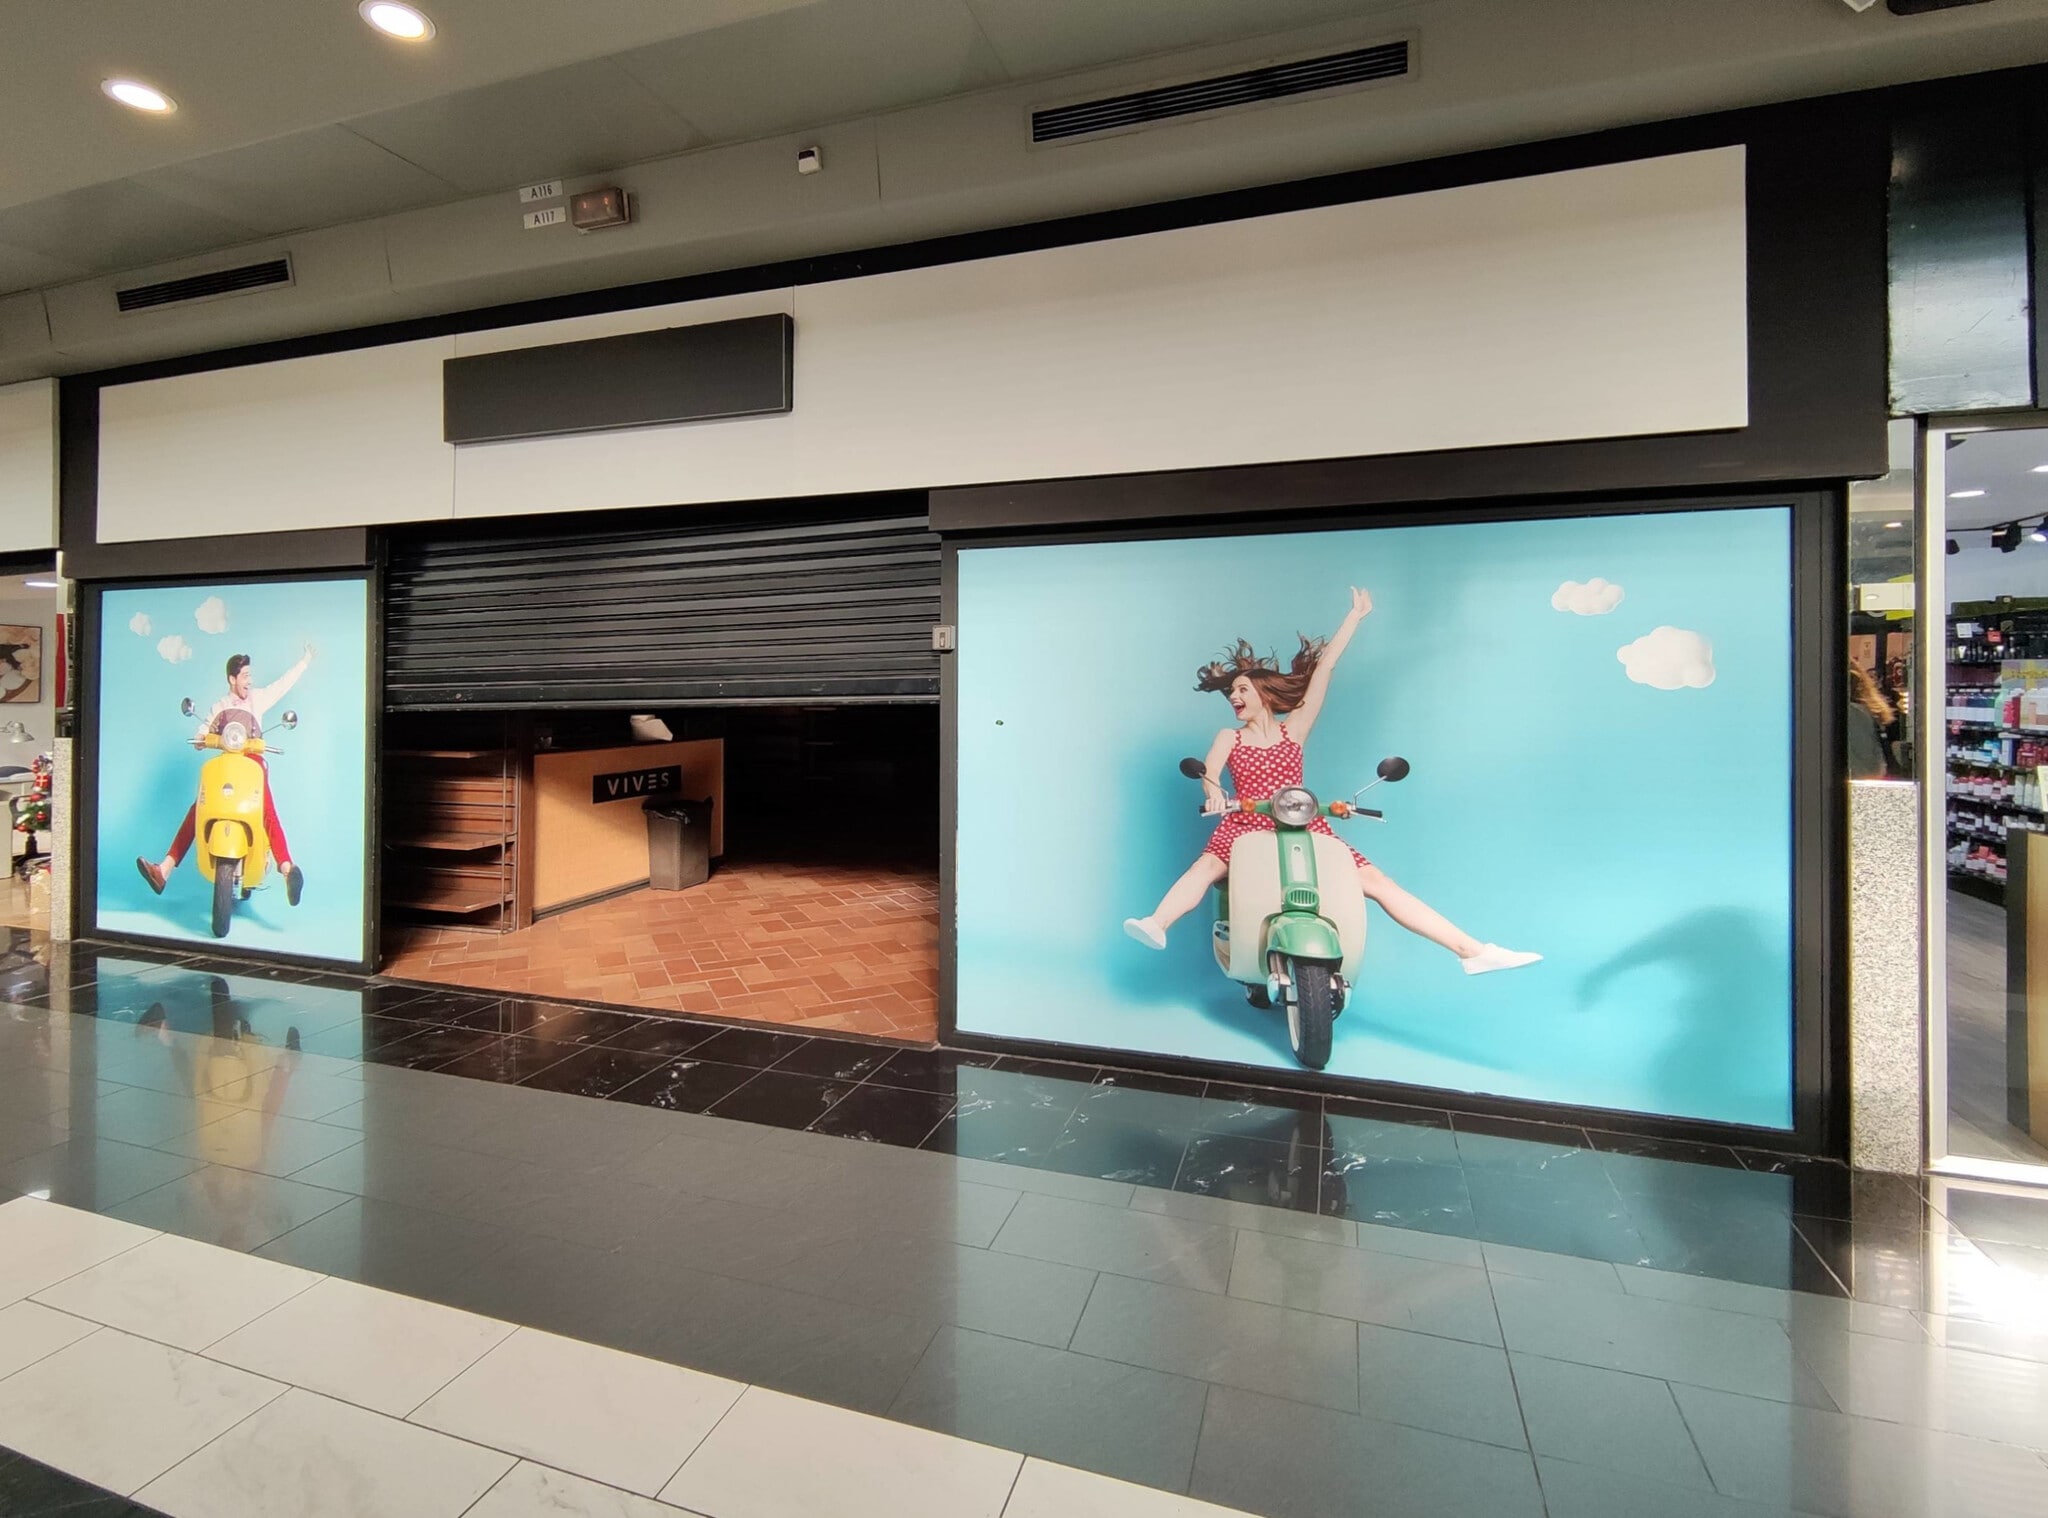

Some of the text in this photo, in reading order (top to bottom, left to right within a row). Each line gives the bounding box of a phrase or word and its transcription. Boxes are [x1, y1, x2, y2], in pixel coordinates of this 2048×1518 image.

[530, 184, 553, 199] A116
[533, 211, 555, 225] A117
[607, 772, 670, 796] VIVES
